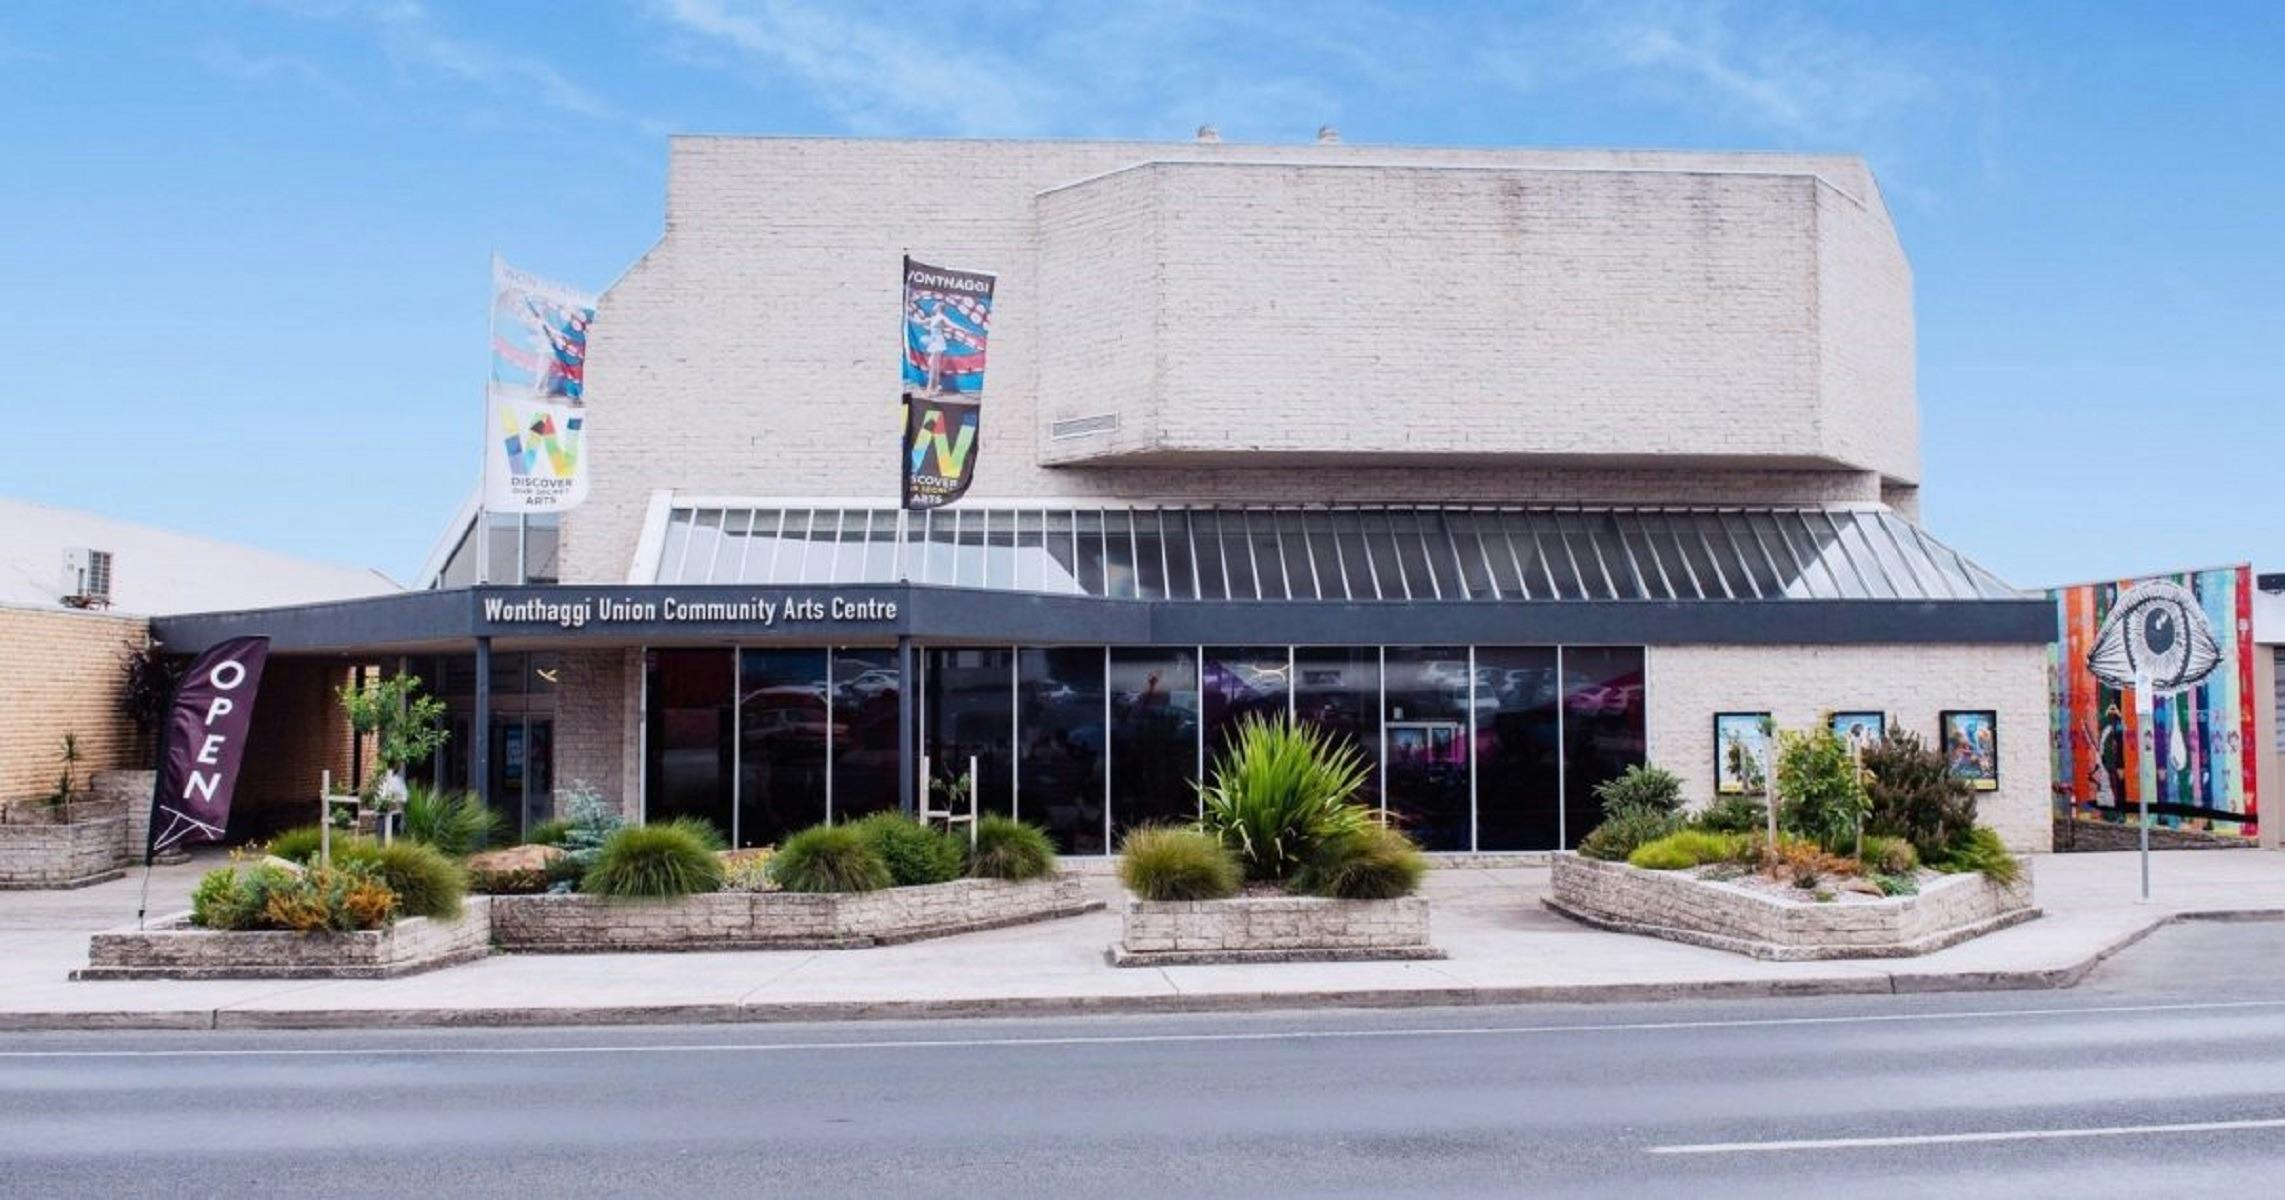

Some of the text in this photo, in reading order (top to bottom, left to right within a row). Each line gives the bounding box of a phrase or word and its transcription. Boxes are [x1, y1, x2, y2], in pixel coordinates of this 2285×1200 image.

[511, 477, 572, 488] DISCOVER
[526, 496, 557, 504] ARTS
[484, 597, 898, 626] Wonthaggi Union Community Arts Centre
[183, 660, 246, 802] OPEN
